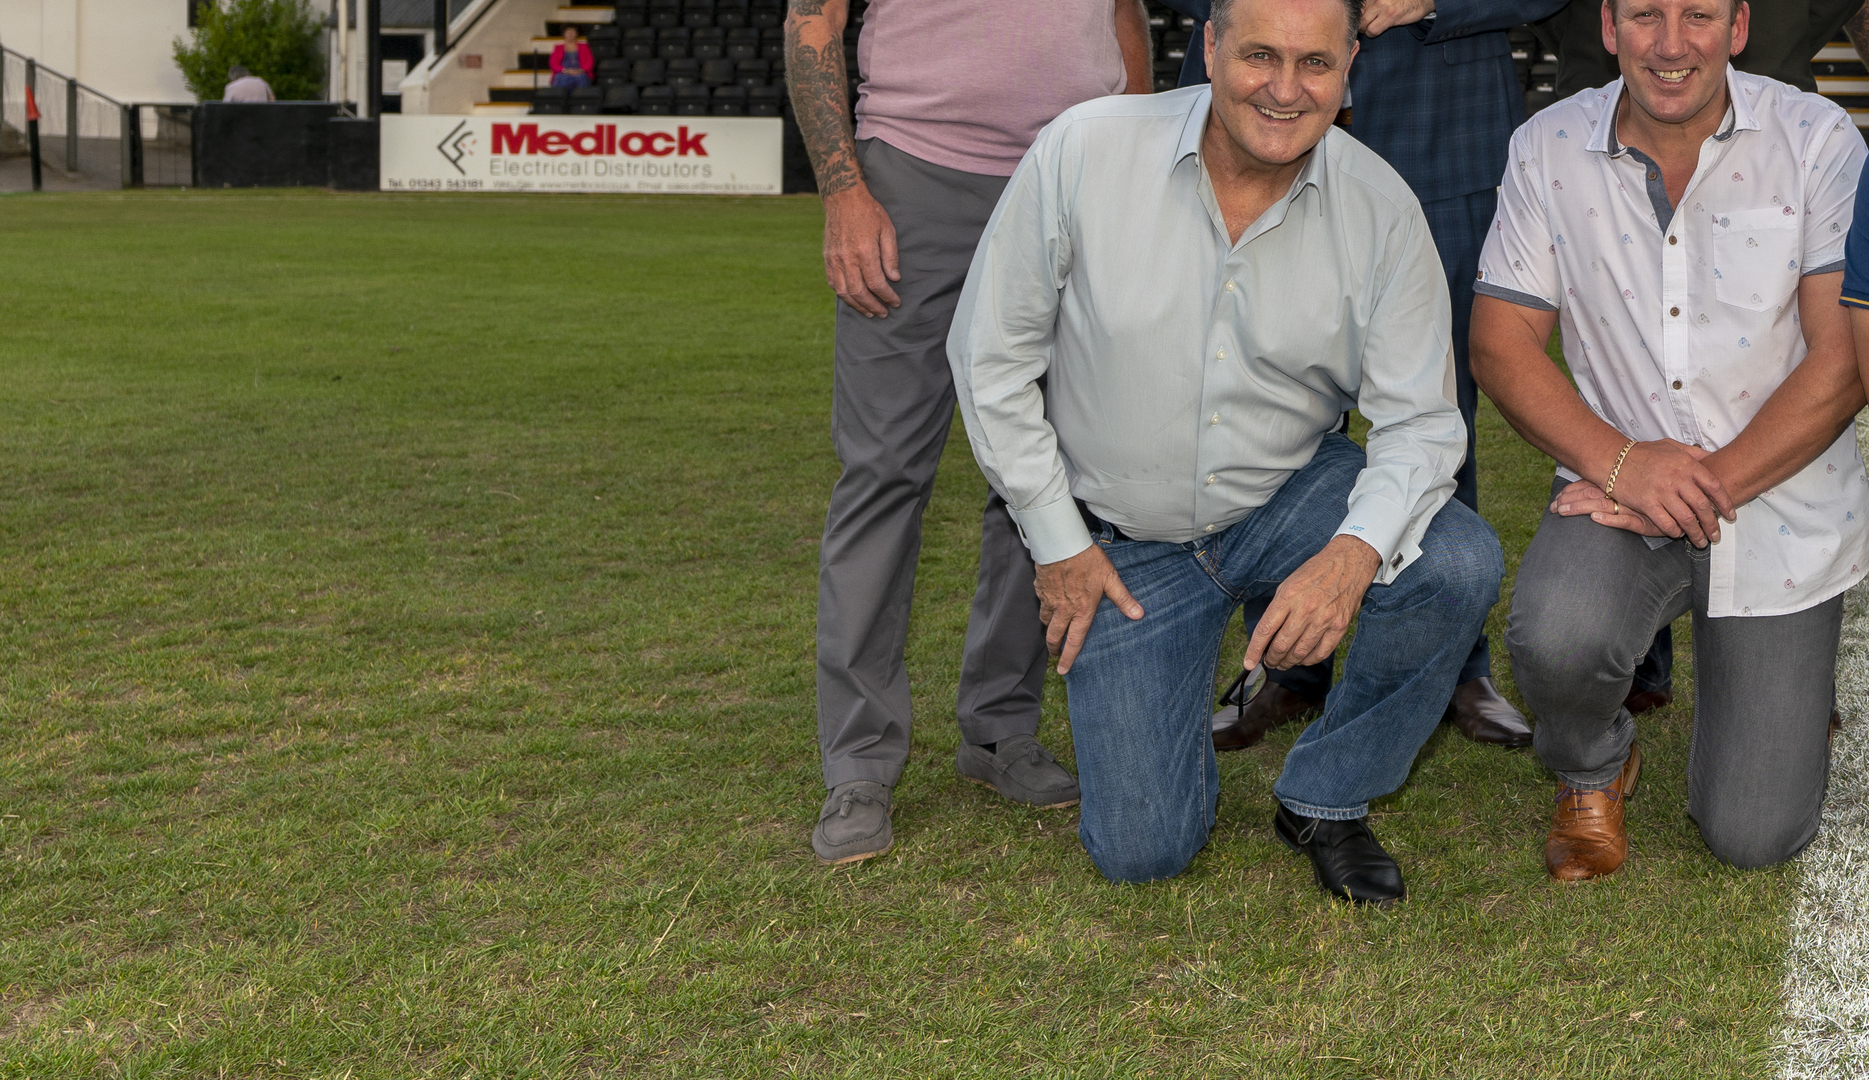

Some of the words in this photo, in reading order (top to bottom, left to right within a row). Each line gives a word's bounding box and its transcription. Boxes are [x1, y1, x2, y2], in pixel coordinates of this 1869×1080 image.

[491, 123, 708, 157] Medlock
[489, 158, 589, 177] Electrical
[594, 158, 712, 178] Distributors
